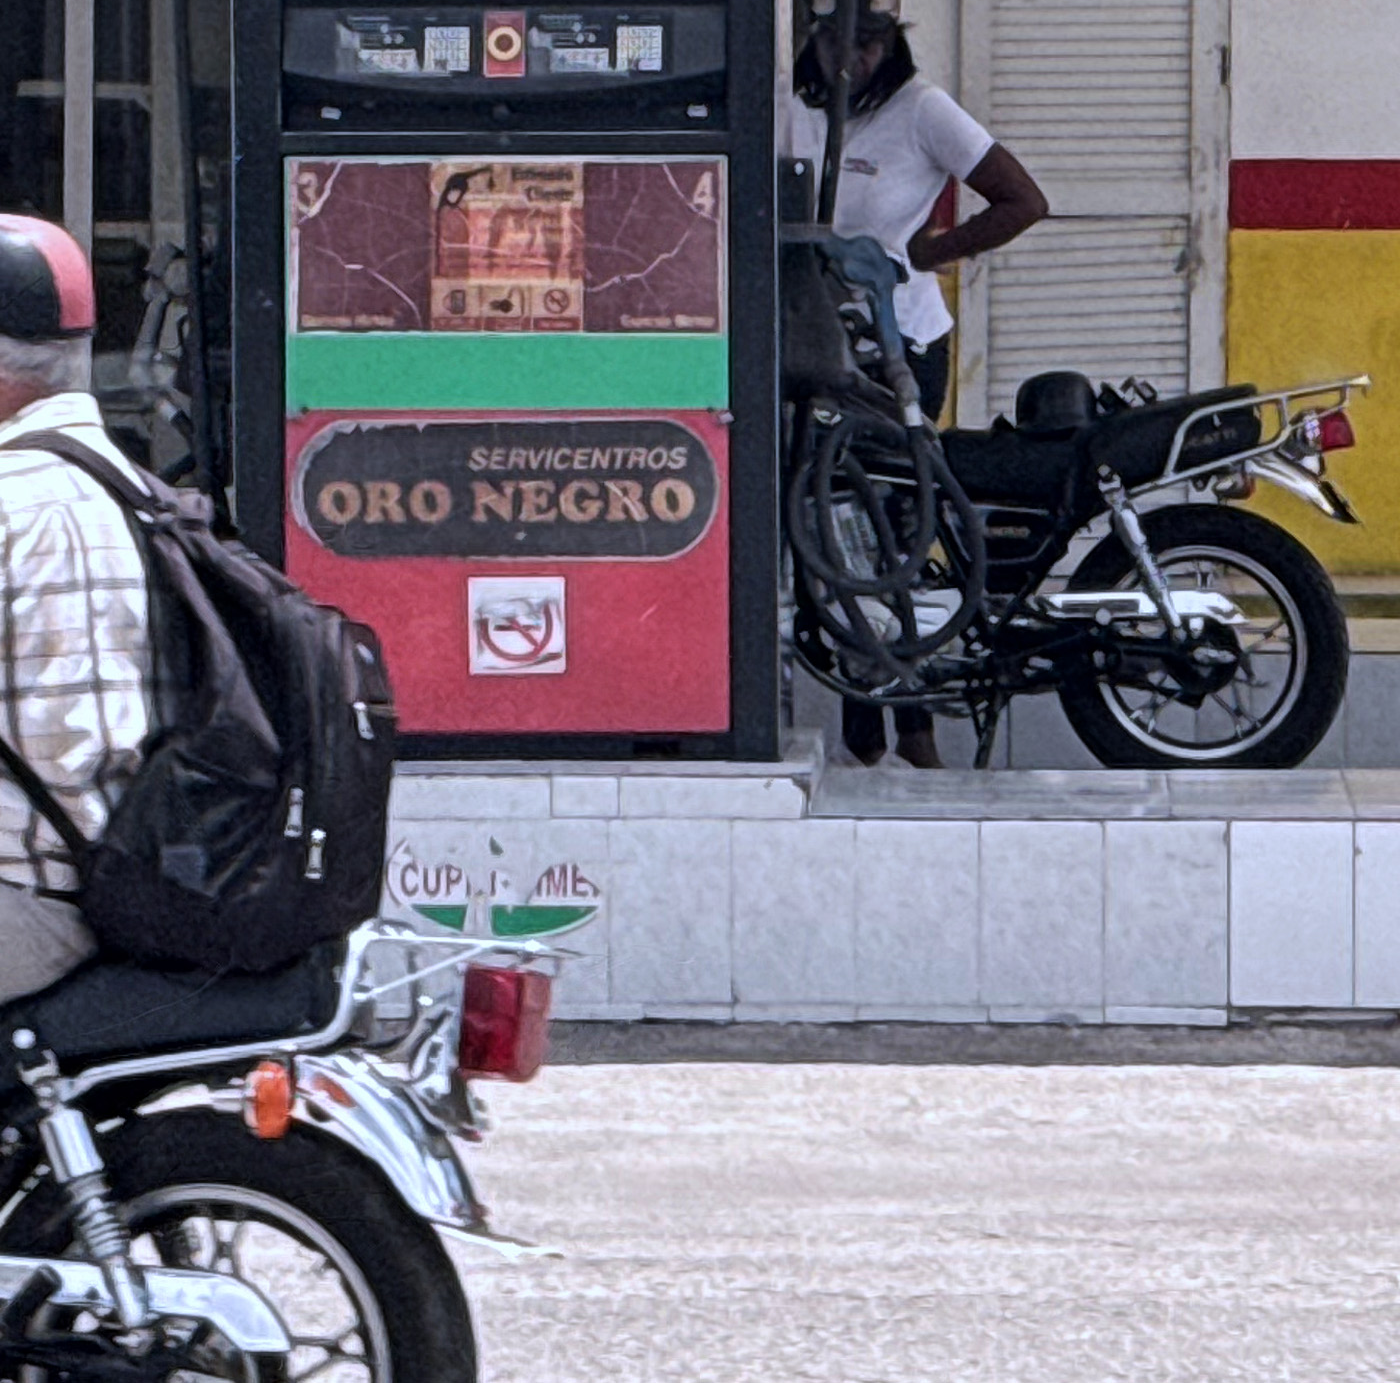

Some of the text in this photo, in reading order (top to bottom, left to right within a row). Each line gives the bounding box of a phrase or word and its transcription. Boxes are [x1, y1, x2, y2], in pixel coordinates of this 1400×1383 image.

[467, 445, 689, 472] SERVICENTROS
[316, 478, 697, 525] ORO NEGRO
